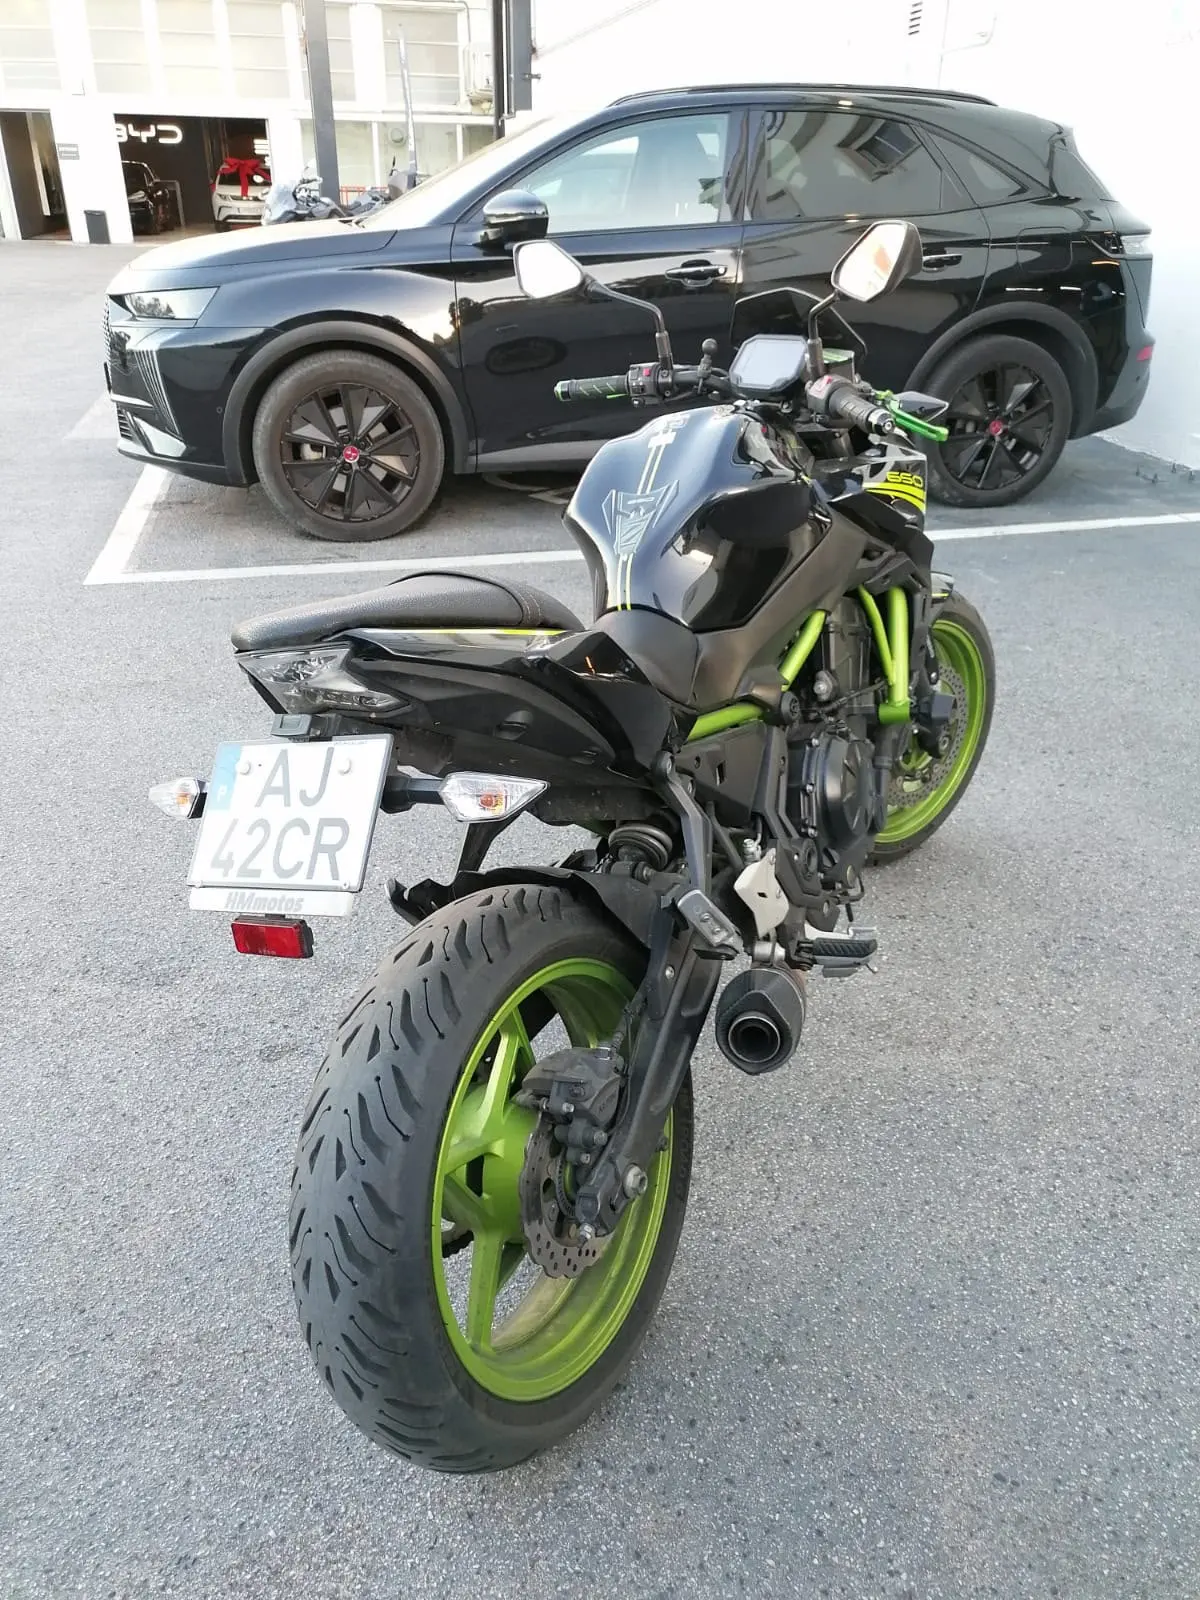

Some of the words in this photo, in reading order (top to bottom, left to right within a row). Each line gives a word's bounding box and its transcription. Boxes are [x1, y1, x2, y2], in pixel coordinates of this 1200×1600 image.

[114, 123, 183, 144] BYD
[886, 471, 923, 488] 650
[254, 746, 335, 808] AJ
[217, 785, 227, 803] P
[210, 817, 350, 881] 42CR
[225, 891, 304, 913] HMmotos
